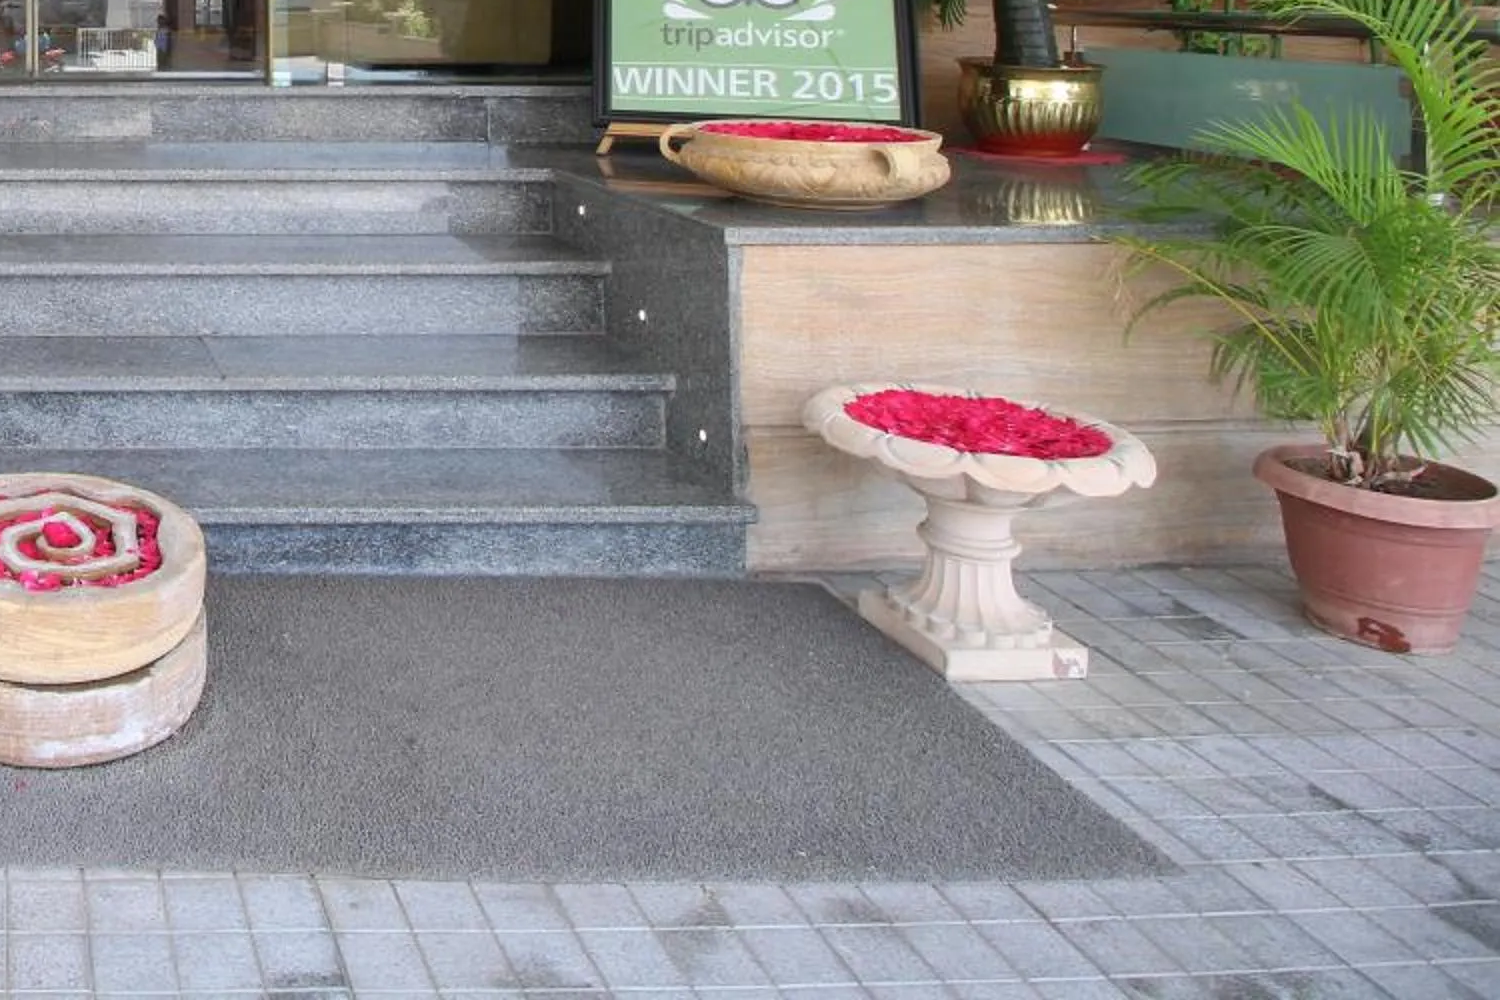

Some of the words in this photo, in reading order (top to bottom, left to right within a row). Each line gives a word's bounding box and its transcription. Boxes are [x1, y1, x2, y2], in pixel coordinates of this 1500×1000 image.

[661, 21, 835, 51] tripadvisor
[612, 67, 779, 98] WINNER
[792, 71, 898, 102] 2015
